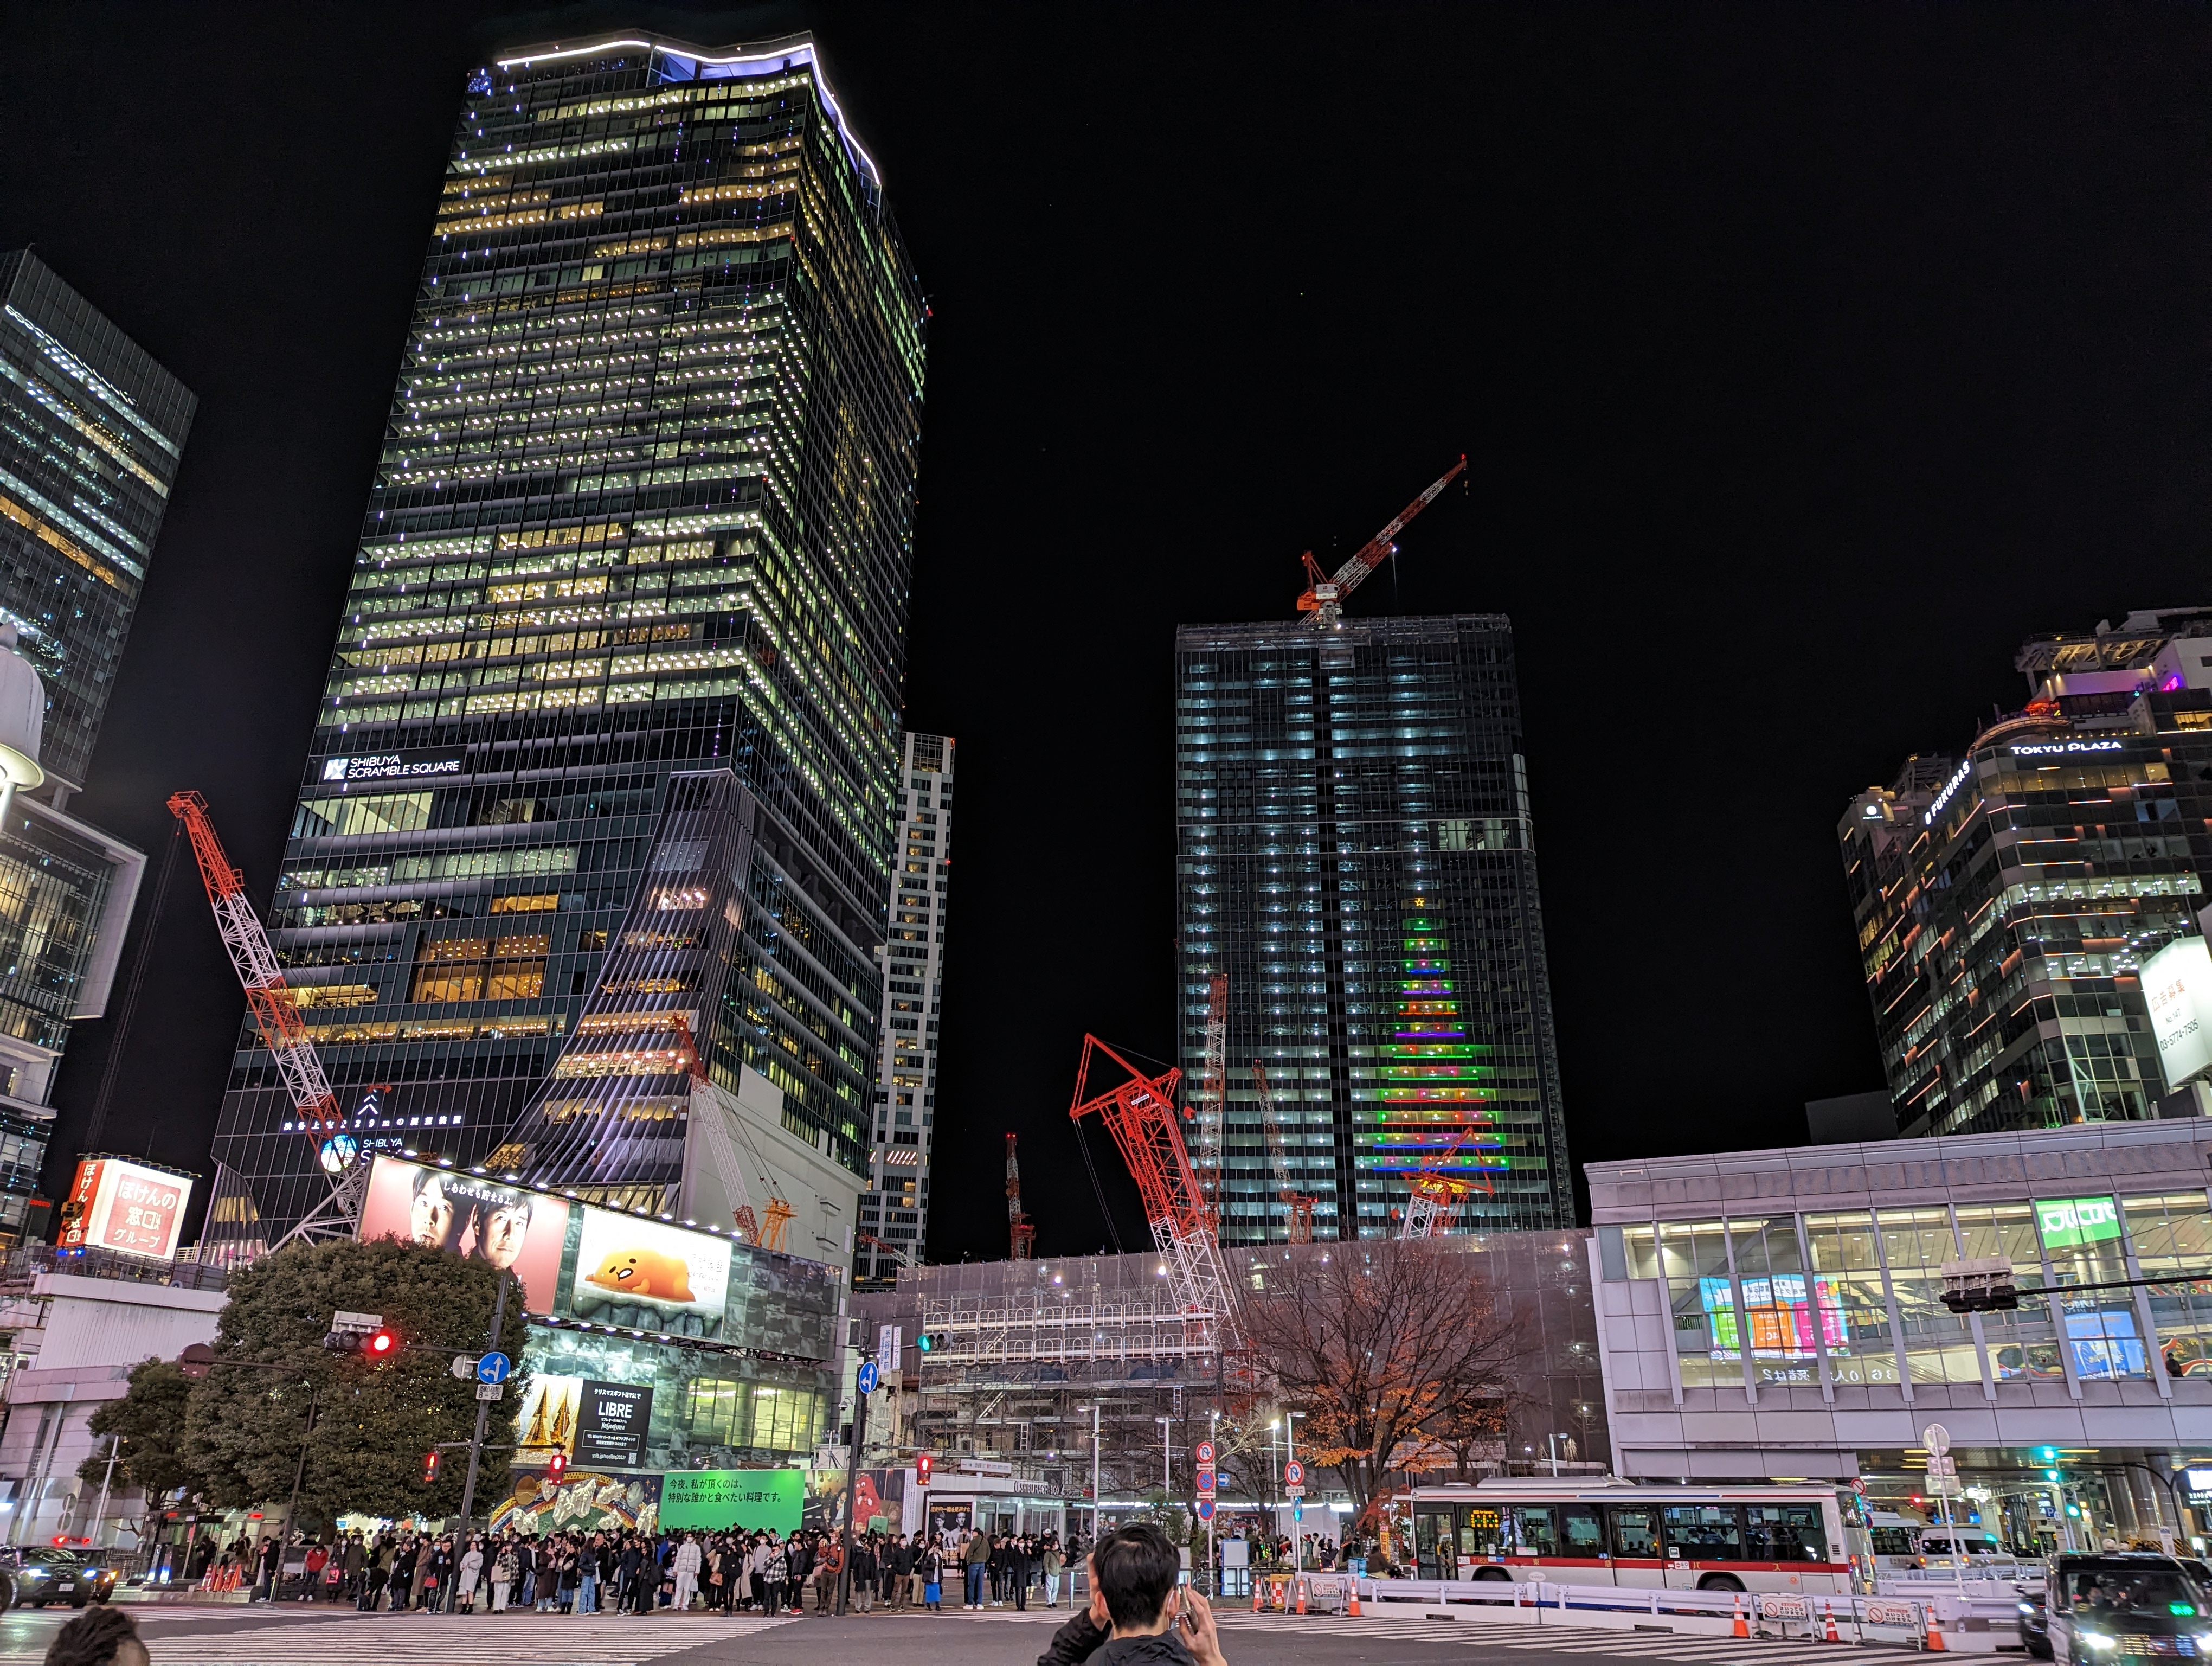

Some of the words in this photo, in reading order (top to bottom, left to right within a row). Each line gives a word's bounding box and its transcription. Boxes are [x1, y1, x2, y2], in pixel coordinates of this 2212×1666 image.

[2010, 745, 2064, 755] TOKYU
[2067, 741, 2123, 752] PLAZA
[347, 765, 410, 779] SCRAMBLE
[411, 761, 460, 774] SQUARE
[350, 755, 401, 768] SHIBUYA
[1931, 760, 1971, 817] FUKURAS
[2151, 979, 2185, 1013] 広告募集
[117, 1179, 177, 1210] ほけんの
[443, 1181, 513, 1207] しあわせも貯まるよ。
[125, 1206, 159, 1231] 窓口
[113, 1228, 161, 1248] グループ
[598, 1401, 633, 1419] LIBRE
[670, 1478, 742, 1490] 今夜、私が頂くのは、
[667, 1491, 782, 1503] 特別な誰かと食べたい料理です。
[2047, 1508, 2054, 1516] P
